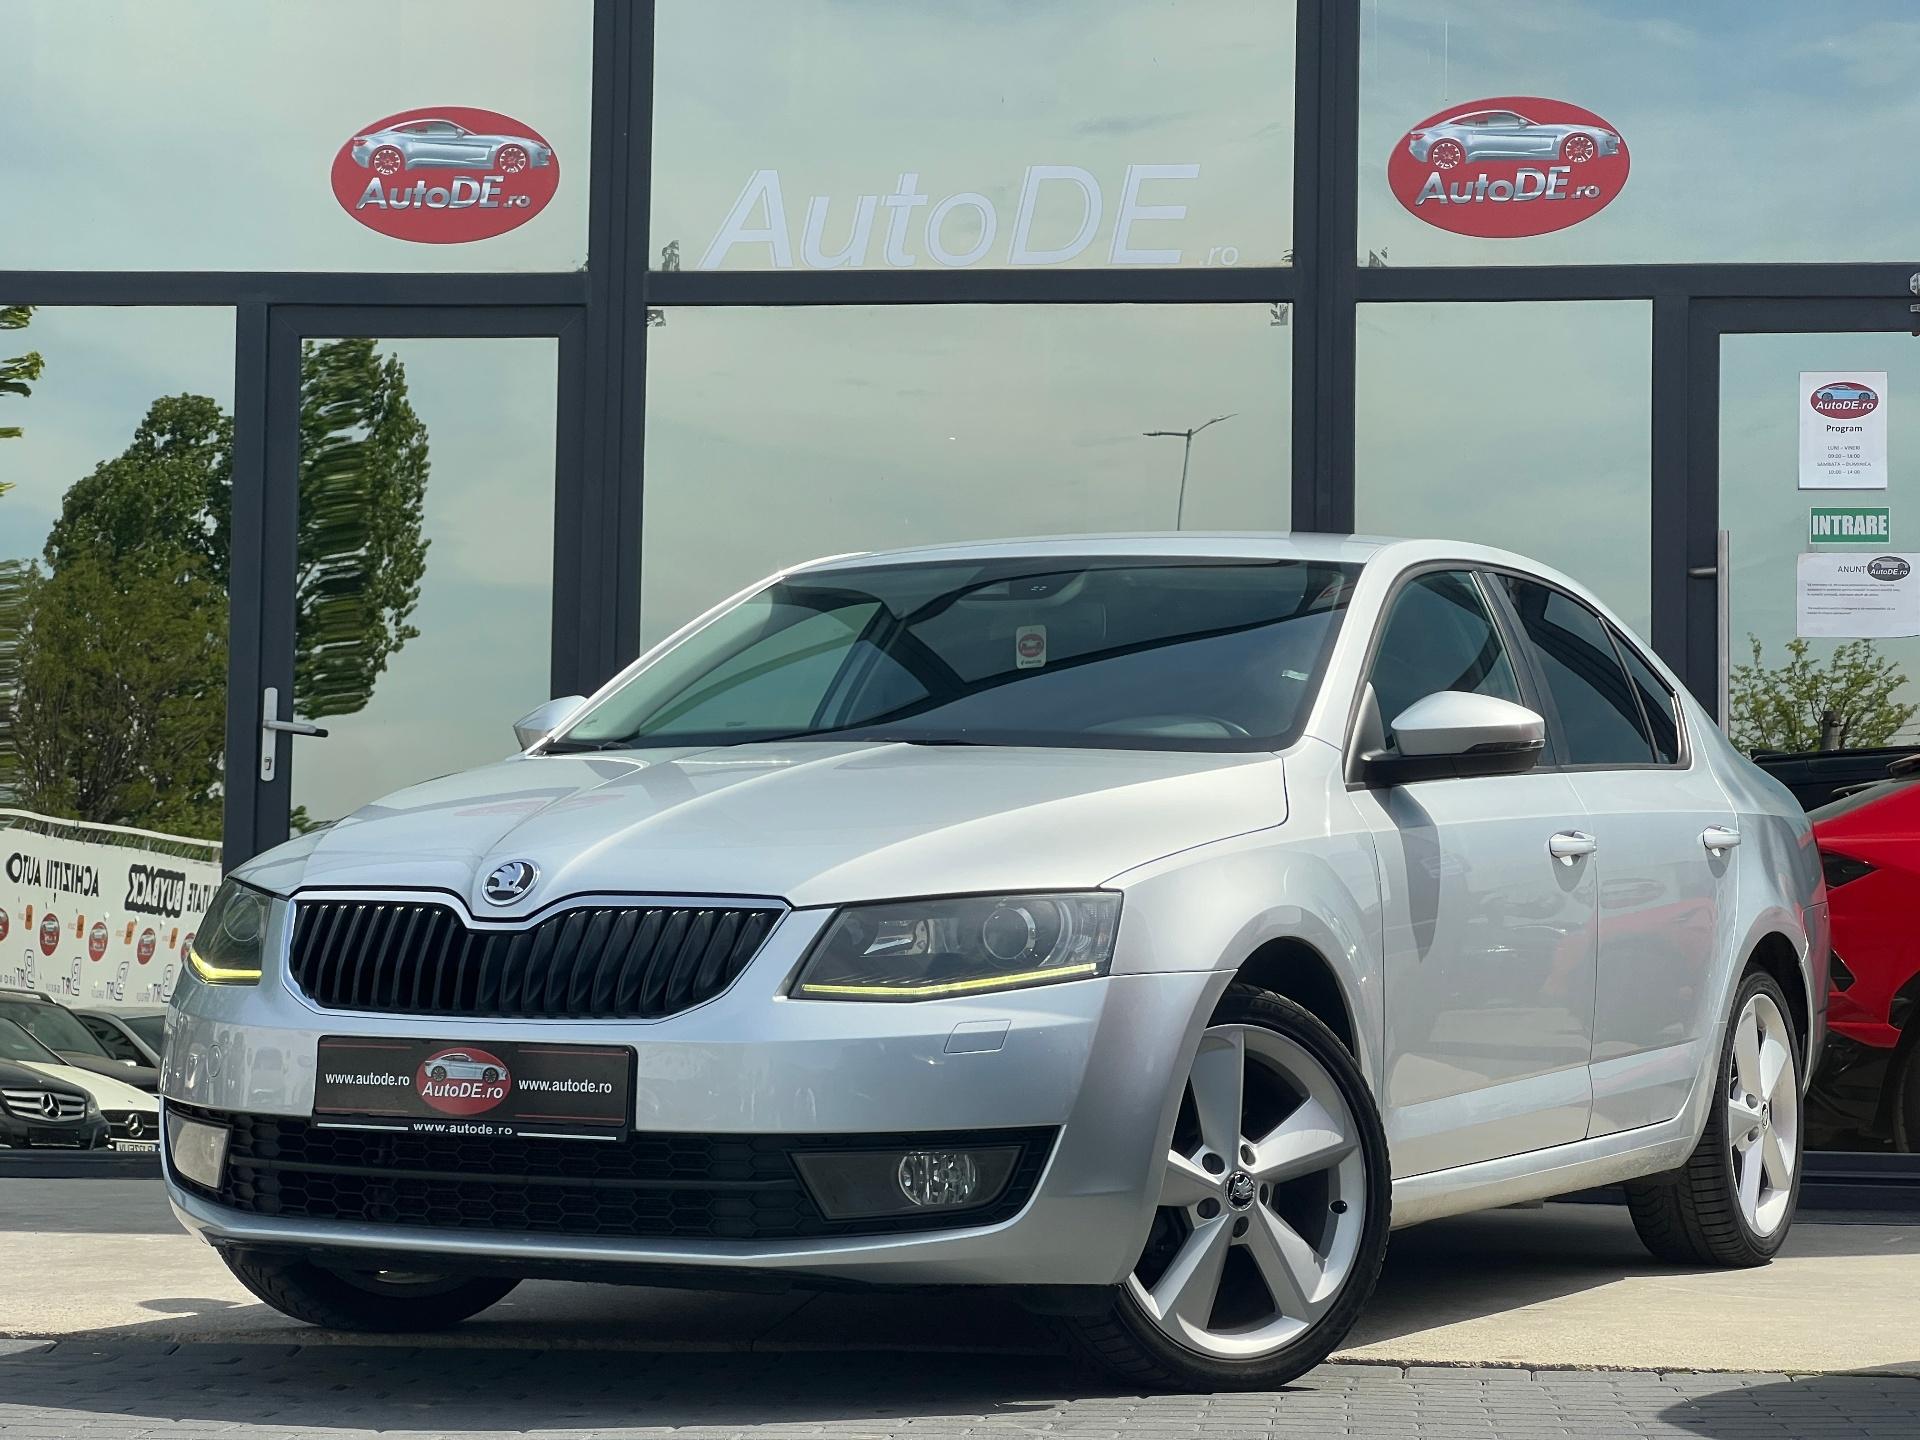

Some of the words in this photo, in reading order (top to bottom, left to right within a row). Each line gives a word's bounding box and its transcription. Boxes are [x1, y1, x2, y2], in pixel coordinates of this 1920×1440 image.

[1815, 400, 1874, 411] AutoDE.ro
[1826, 425, 1863, 434] Program
[1812, 514, 1888, 536] INTRARE
[1870, 568, 1908, 576] AutoDE.ro
[325, 1072, 410, 1087] www.autode.ro
[518, 1077, 612, 1094] www.autode.ro
[421, 1082, 504, 1099] AutoDE.ro
[413, 1121, 513, 1136] www.autode.ro
